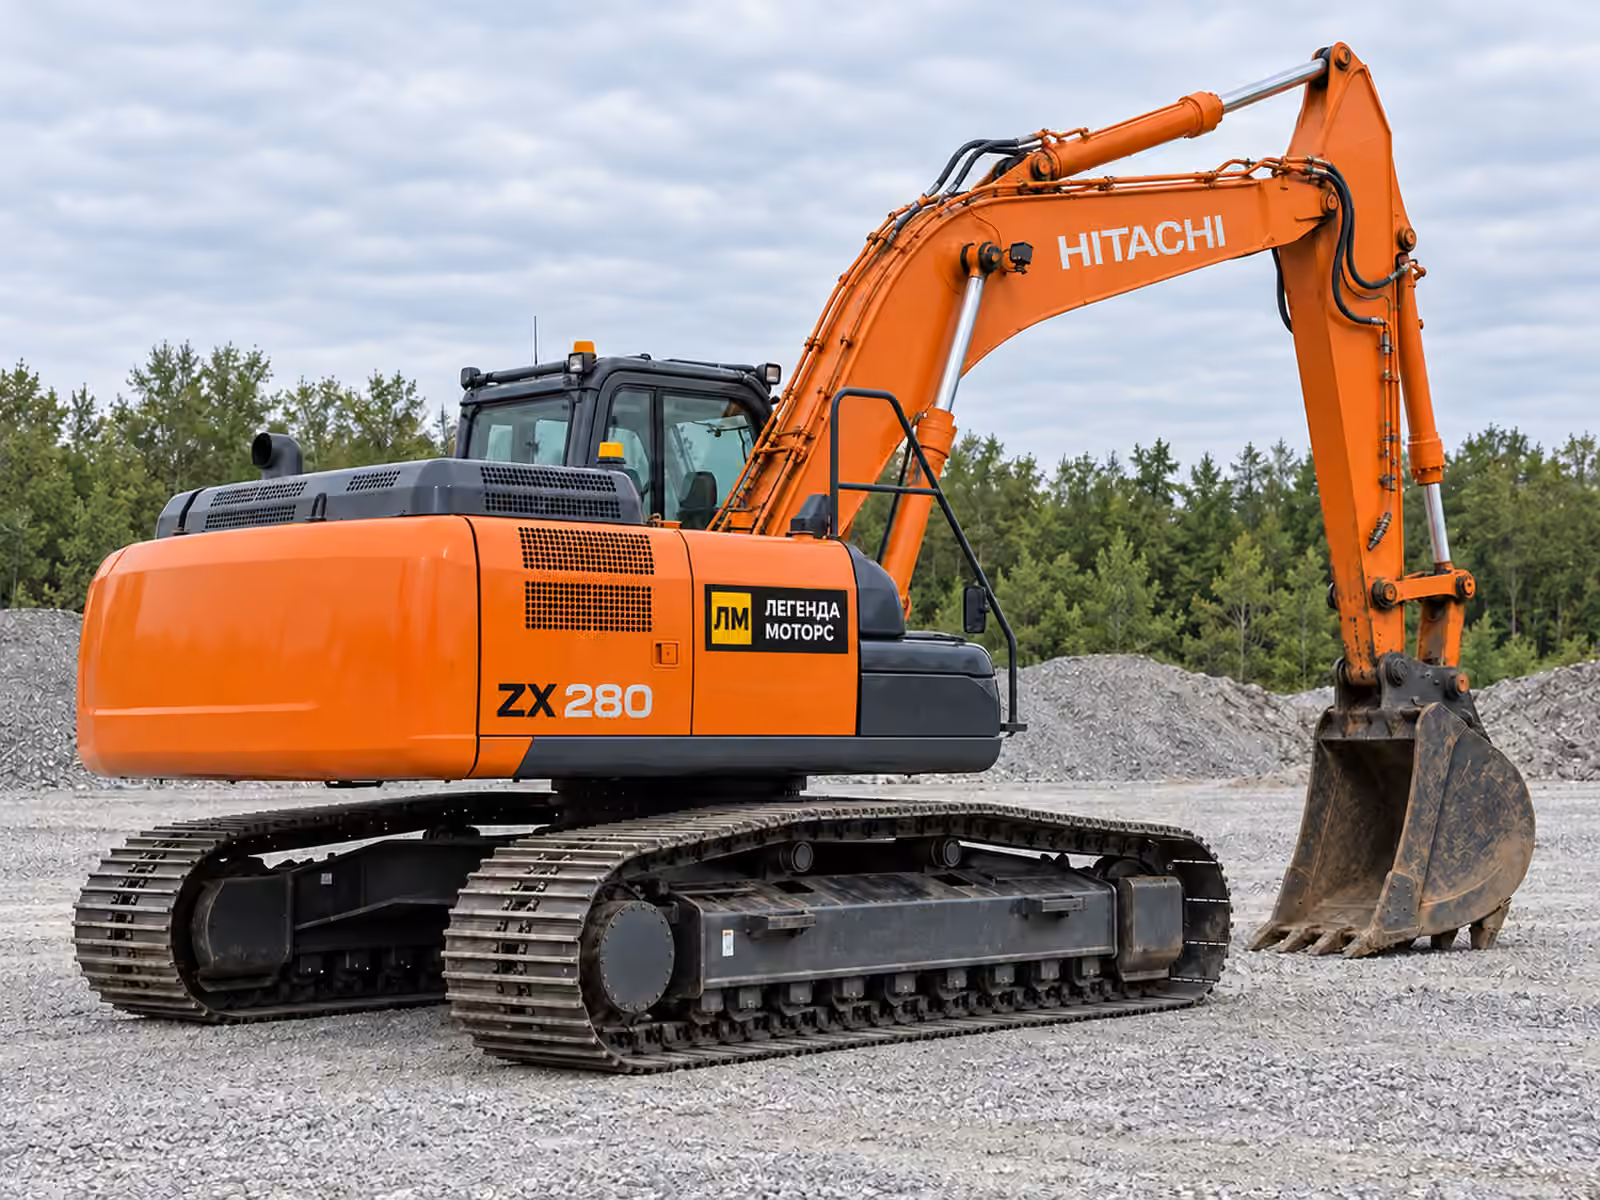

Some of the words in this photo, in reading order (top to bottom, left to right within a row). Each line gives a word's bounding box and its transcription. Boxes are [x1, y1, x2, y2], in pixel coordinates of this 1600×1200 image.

[1058, 215, 1226, 269] HITACHI
[713, 606, 749, 631] ЛМ
[764, 599, 841, 621] ЛЕГЕНДА
[765, 623, 835, 641] МОТОРС
[496, 683, 557, 718] ZX
[563, 683, 653, 719] 280
